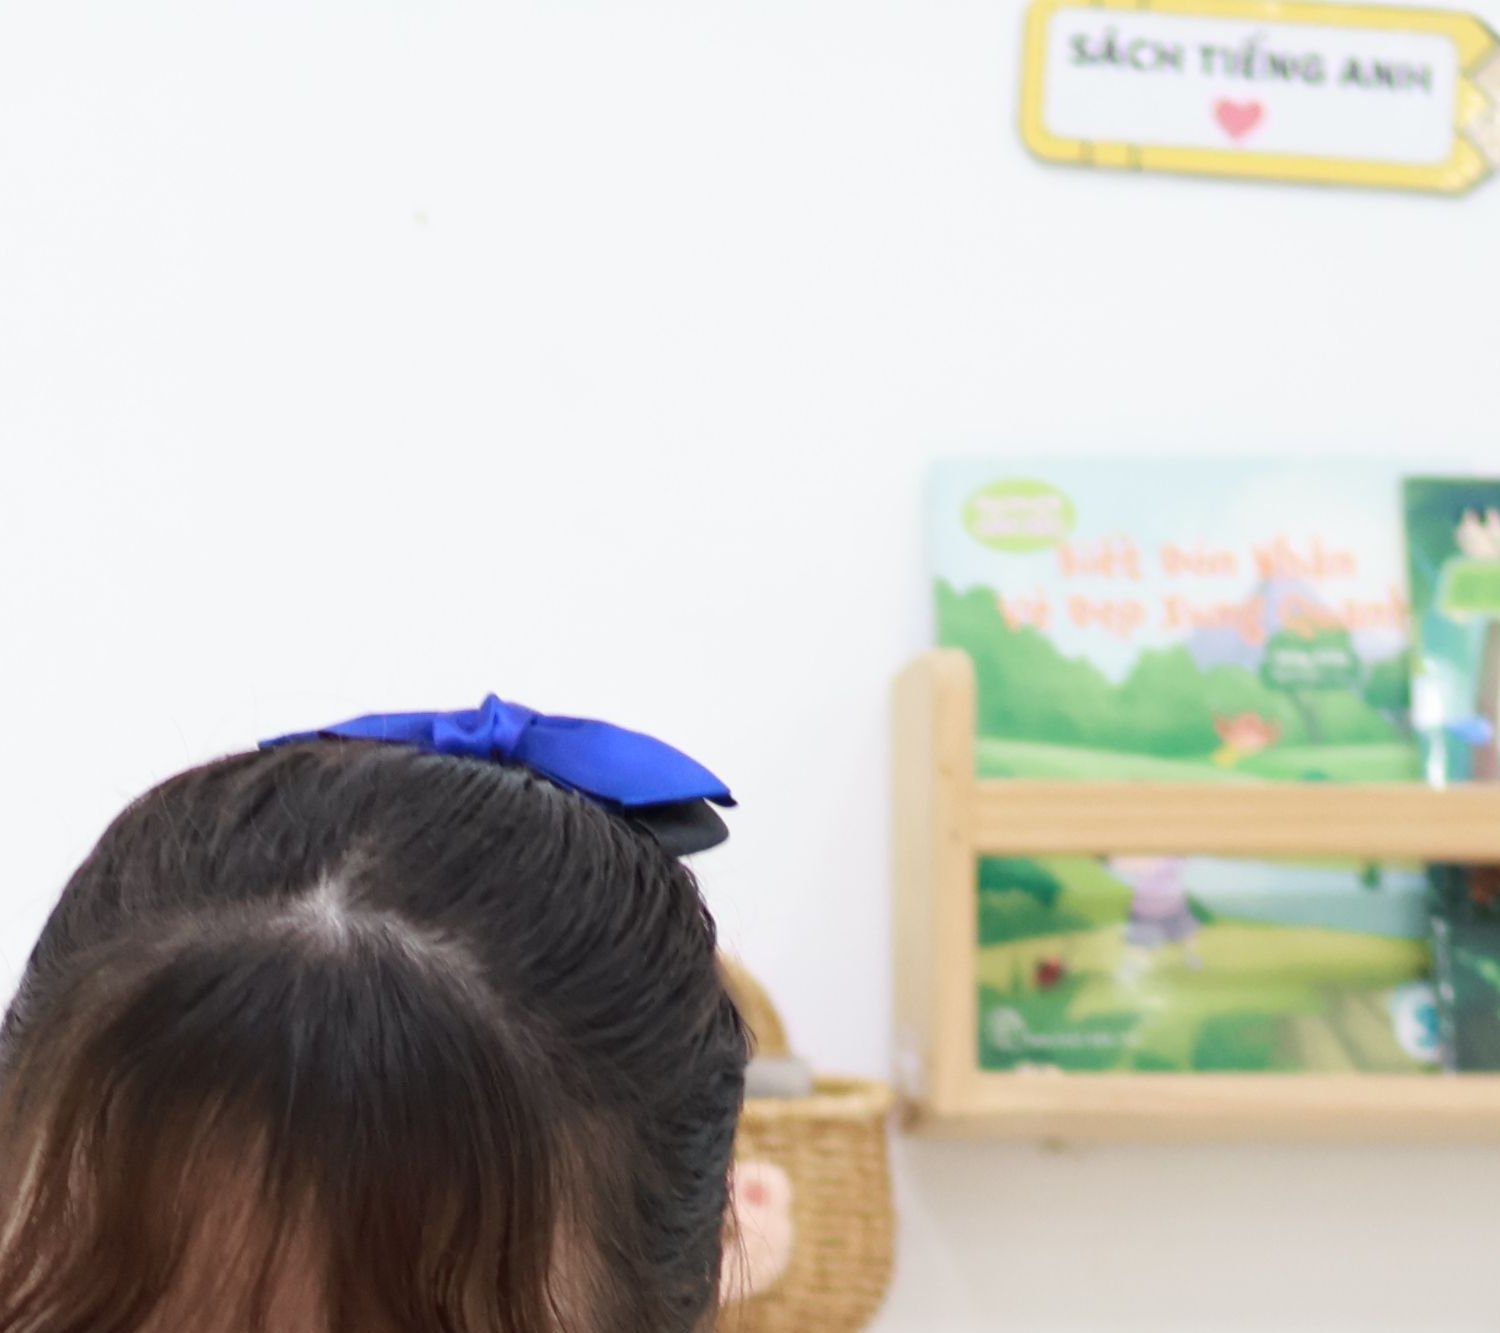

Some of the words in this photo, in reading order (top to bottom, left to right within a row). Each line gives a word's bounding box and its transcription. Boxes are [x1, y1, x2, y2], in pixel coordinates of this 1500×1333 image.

[1069, 24, 1184, 73] SÁCH
[1199, 30, 1326, 86] TIẾNG
[1338, 56, 1433, 94] ANH
